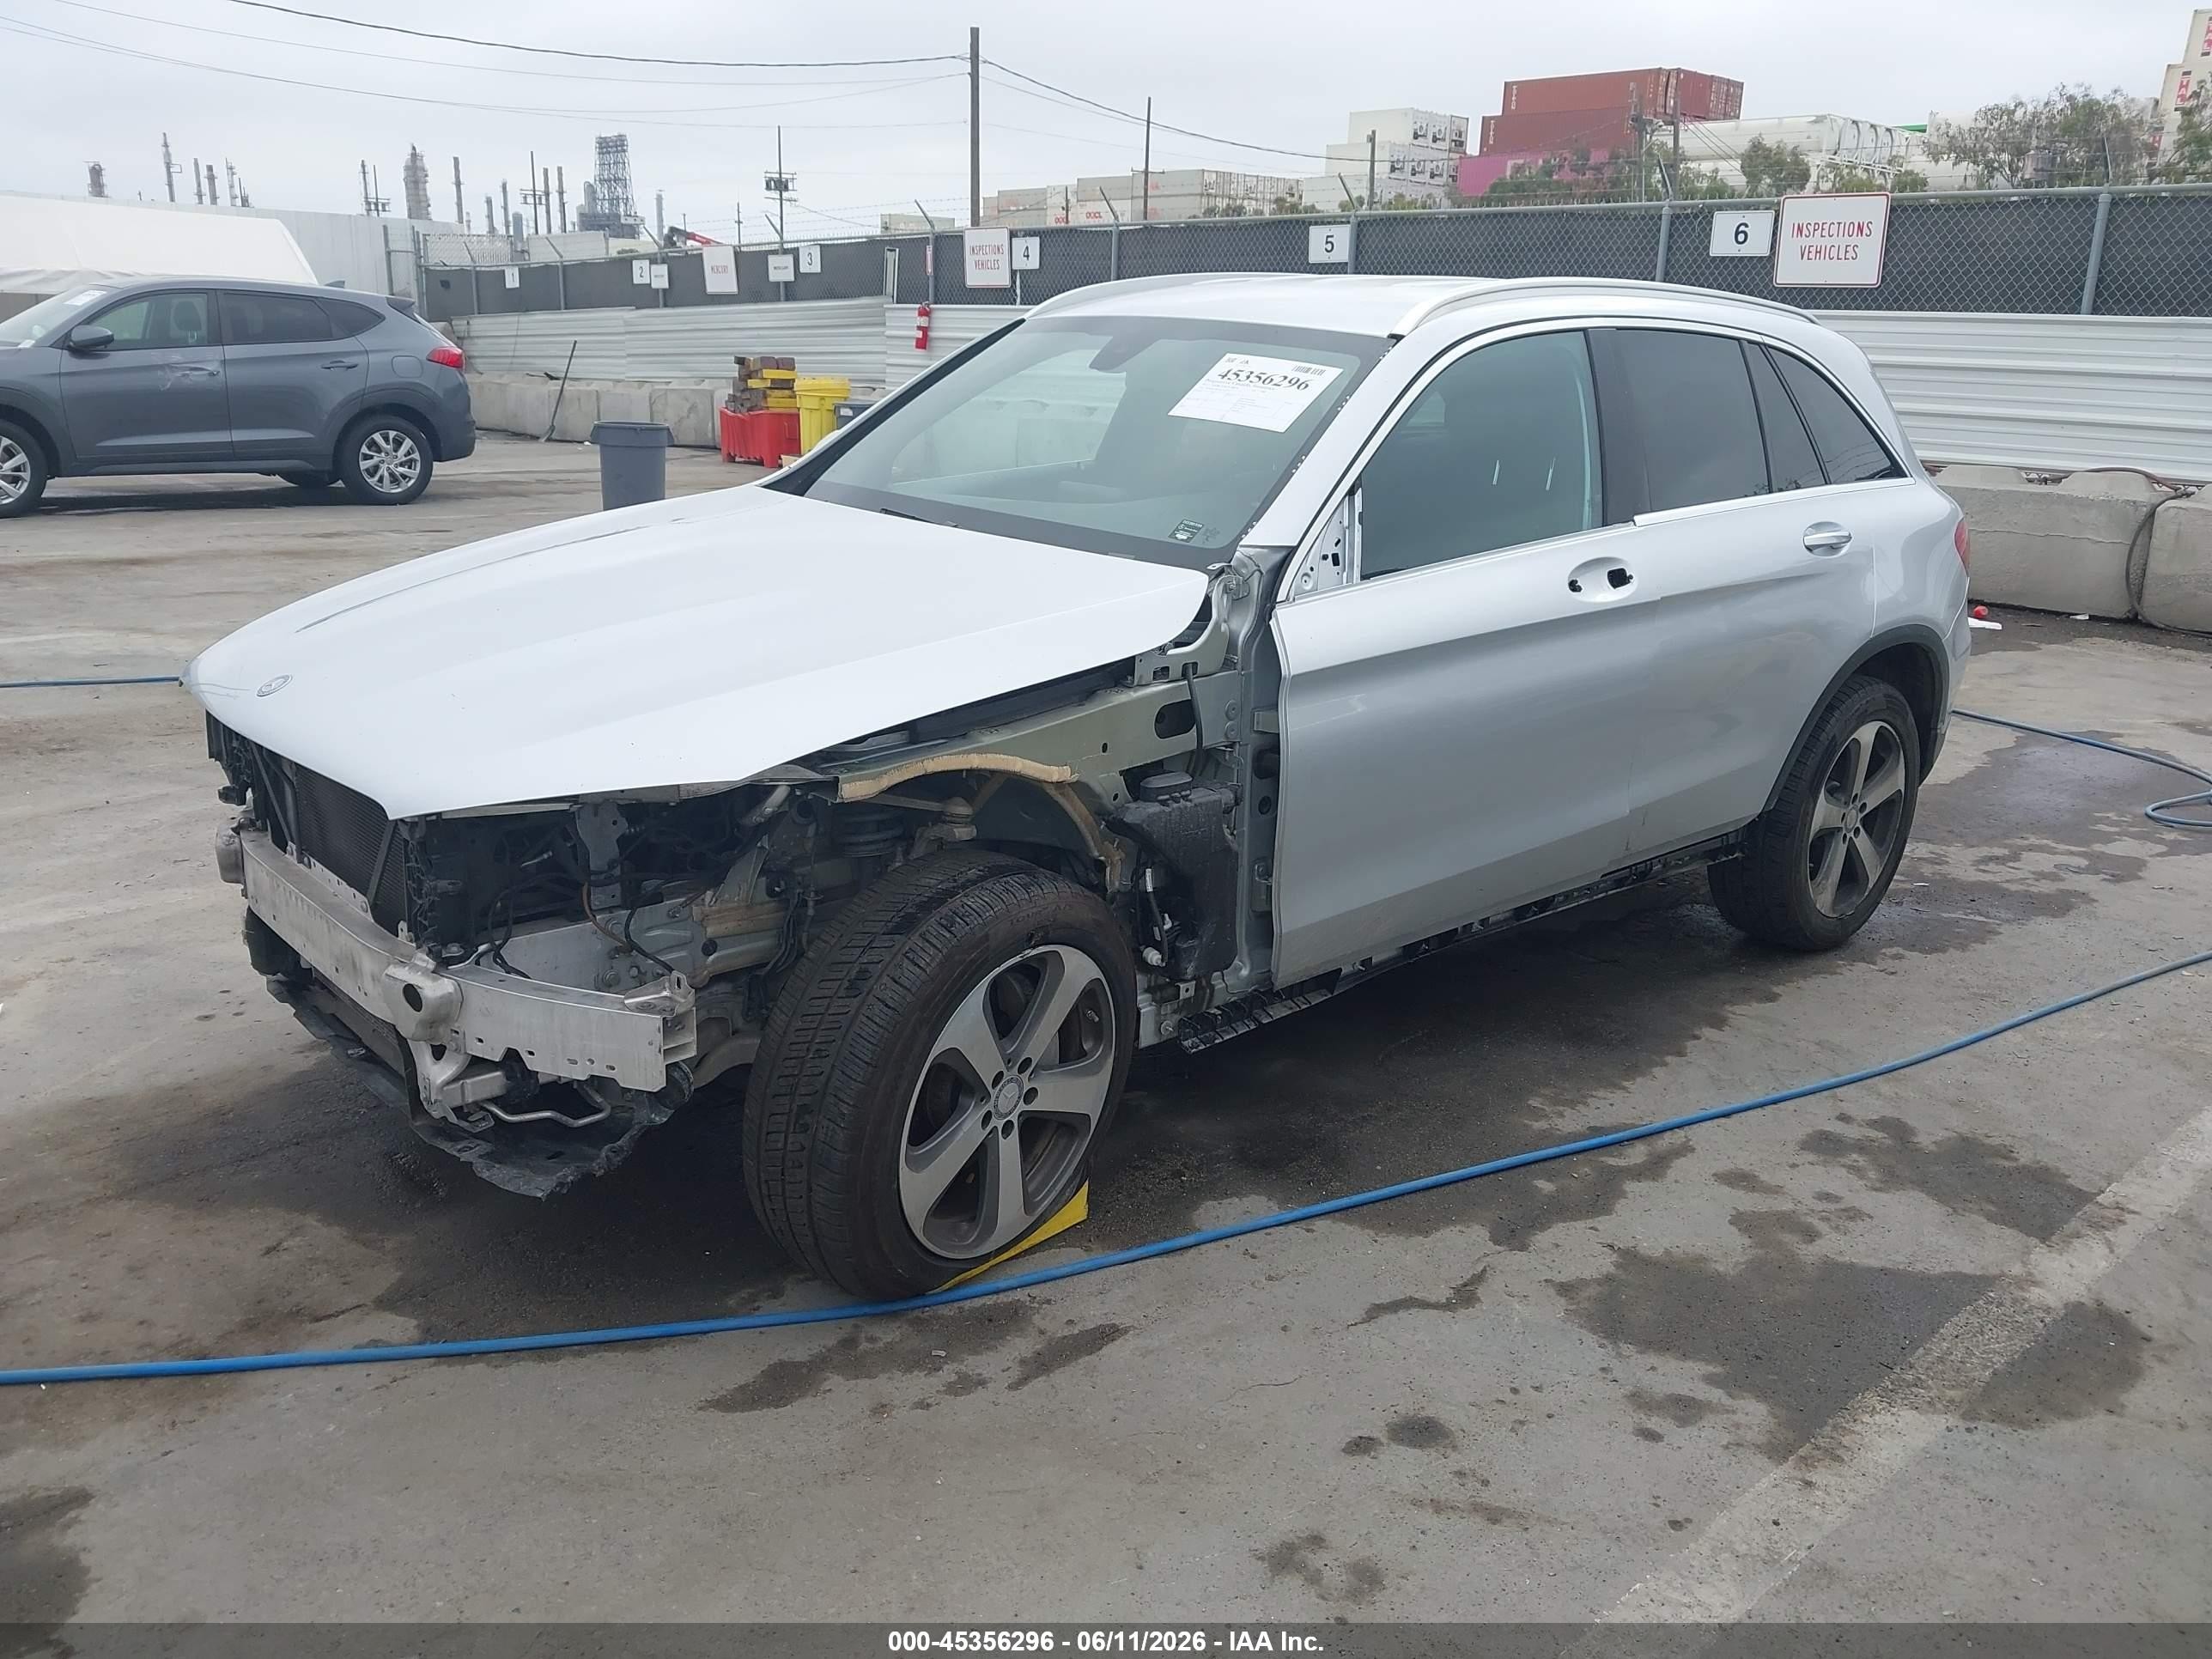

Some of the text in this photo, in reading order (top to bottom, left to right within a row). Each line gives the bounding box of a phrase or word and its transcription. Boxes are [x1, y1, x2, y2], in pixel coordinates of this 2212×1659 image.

[1734, 222, 1749, 245] 6
[1791, 221, 1873, 238] INSPECTIONS
[969, 244, 1005, 255] INSPECTIONS
[1324, 234, 1334, 253] 5
[807, 252, 813, 266] 3
[1023, 246, 1030, 261] 4
[1800, 244, 1859, 261] VEHICLES
[639, 266, 644, 278] 2
[975, 259, 1000, 270] VEHICLES
[1218, 368, 1314, 391] 45356296
